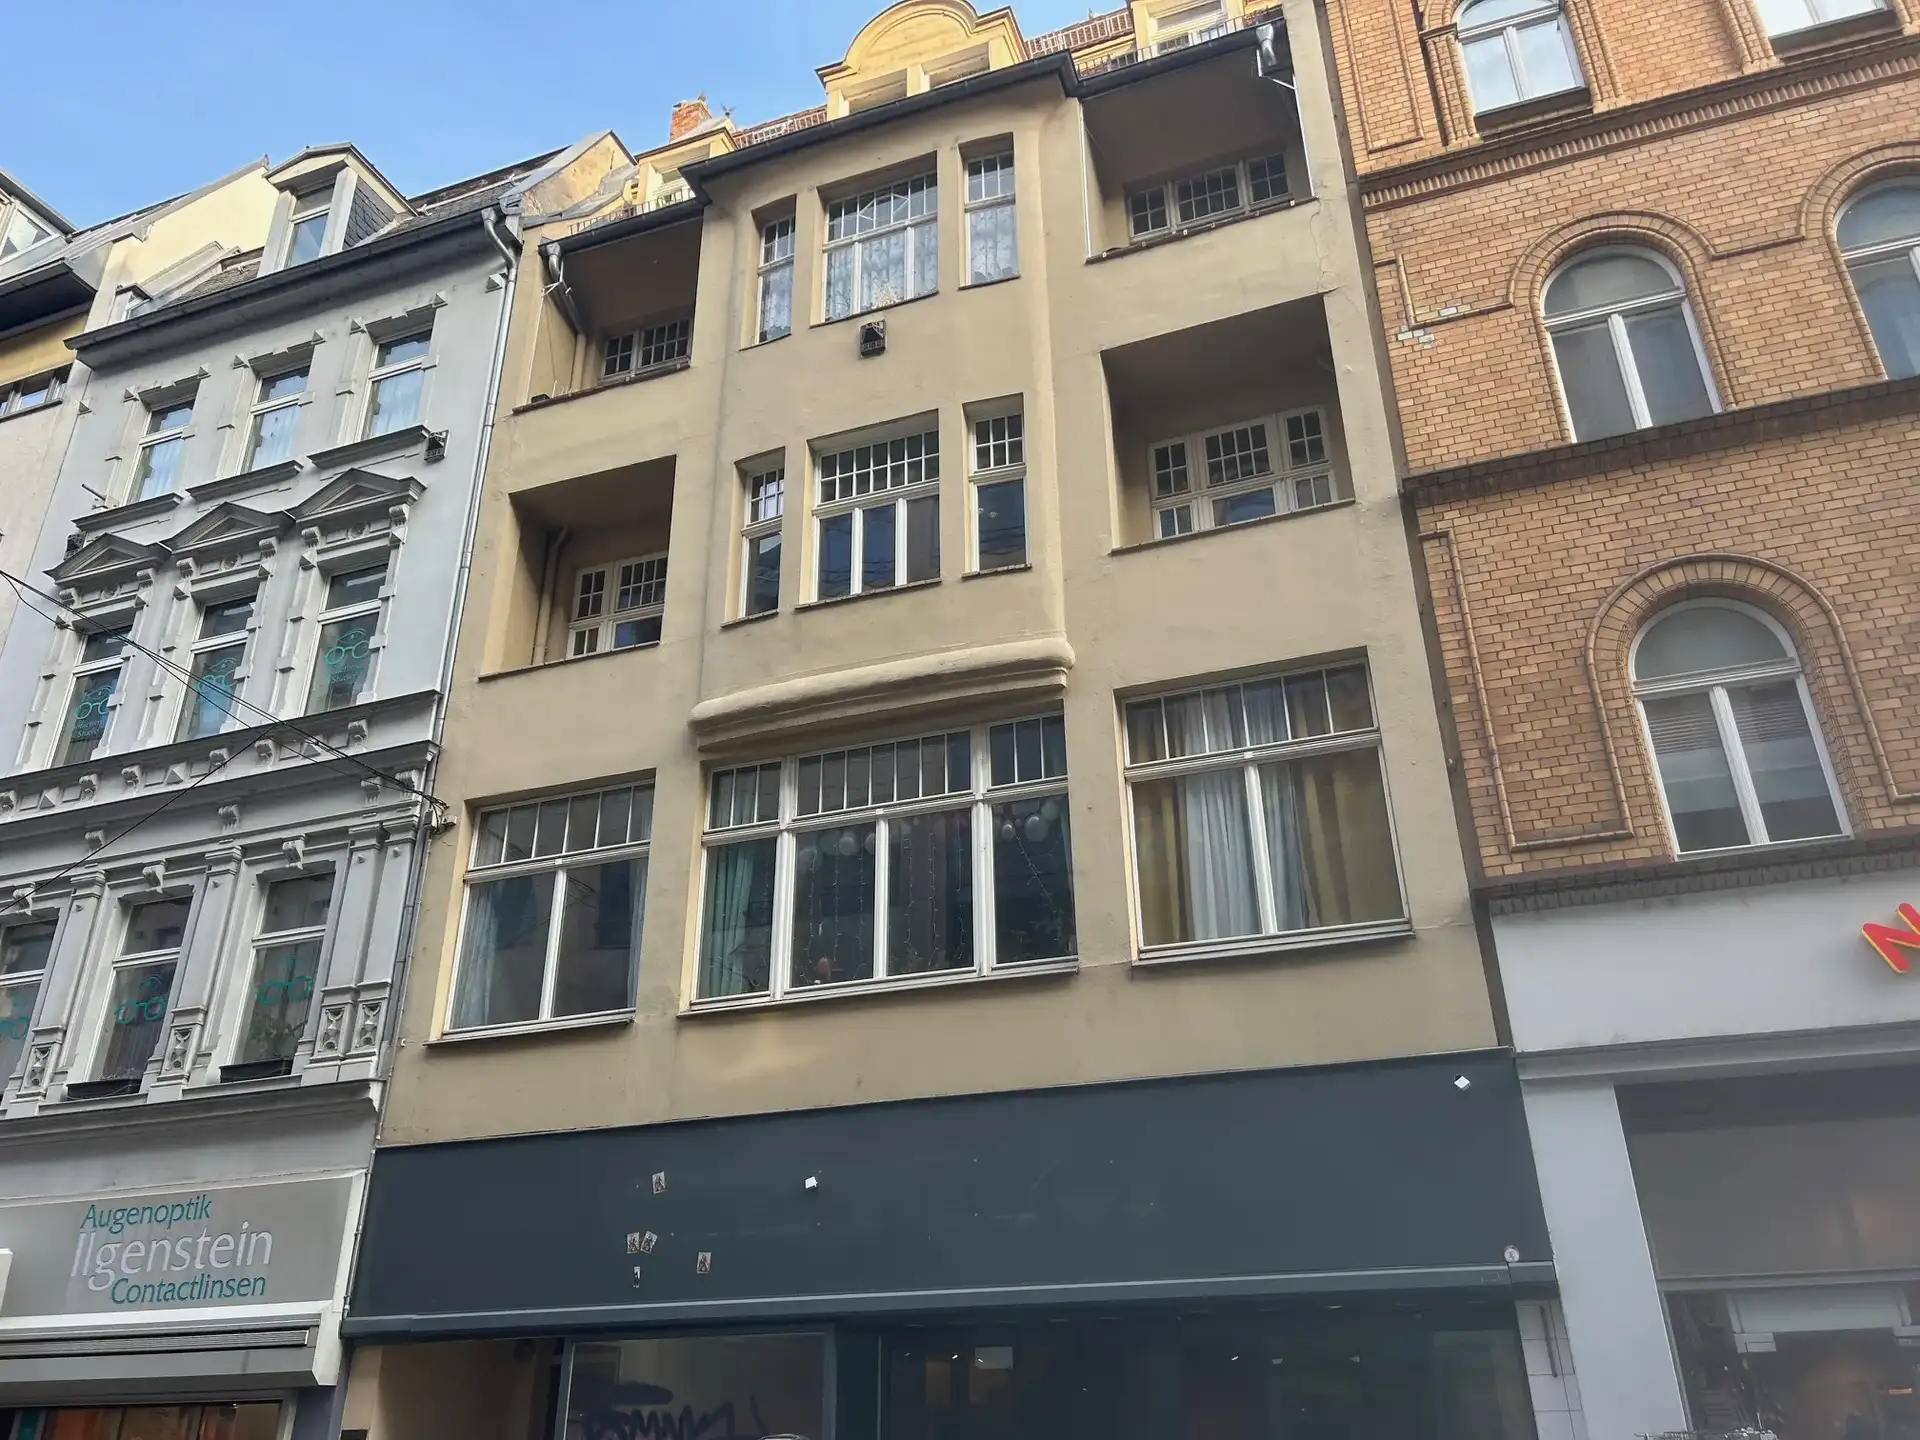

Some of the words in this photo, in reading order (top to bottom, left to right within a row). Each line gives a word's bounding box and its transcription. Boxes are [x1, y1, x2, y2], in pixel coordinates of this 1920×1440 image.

[80, 1194, 212, 1235] Augenoptik
[71, 1220, 273, 1291] Ilgenstein
[111, 1273, 266, 1305] Contactlinsen
